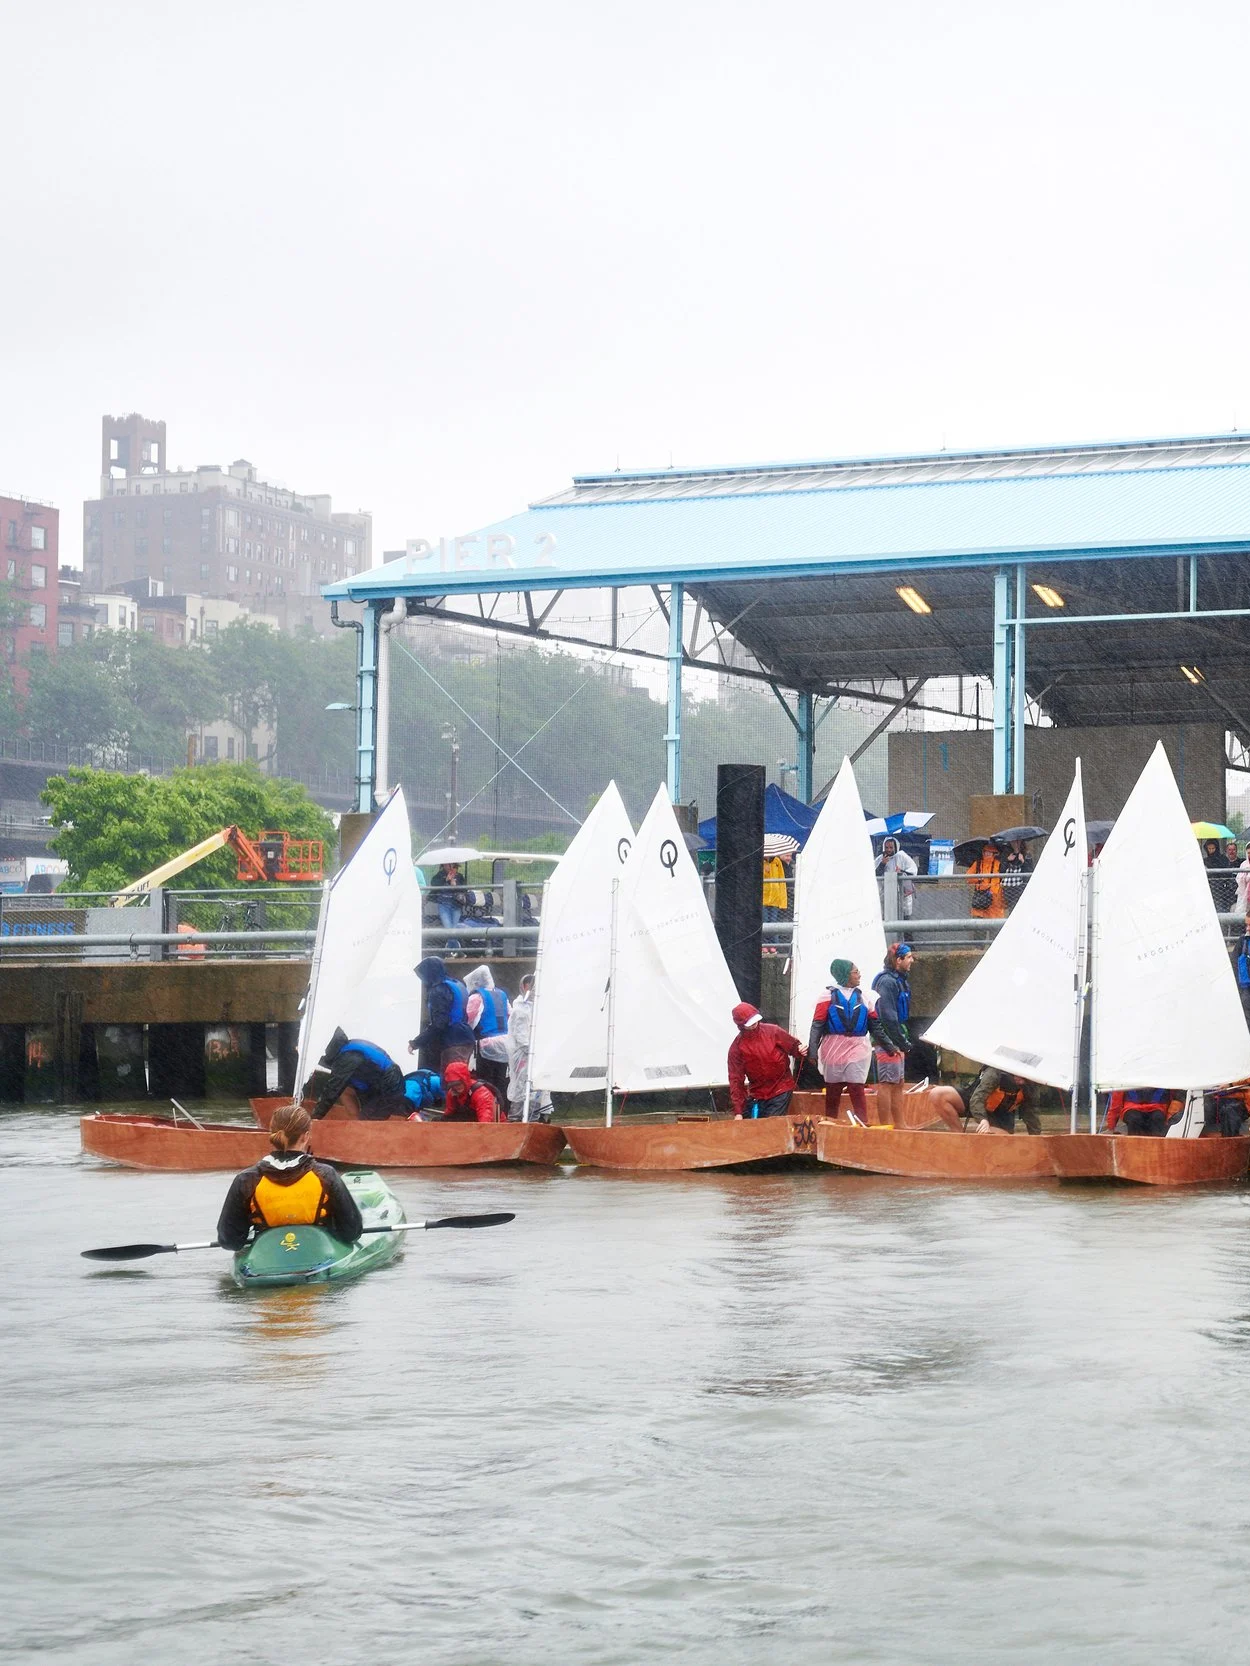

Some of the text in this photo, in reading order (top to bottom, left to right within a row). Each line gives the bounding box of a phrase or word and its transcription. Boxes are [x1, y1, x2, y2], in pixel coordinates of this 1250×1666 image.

[406, 531, 557, 575] PIER 2
[938, 742, 949, 773] 1
